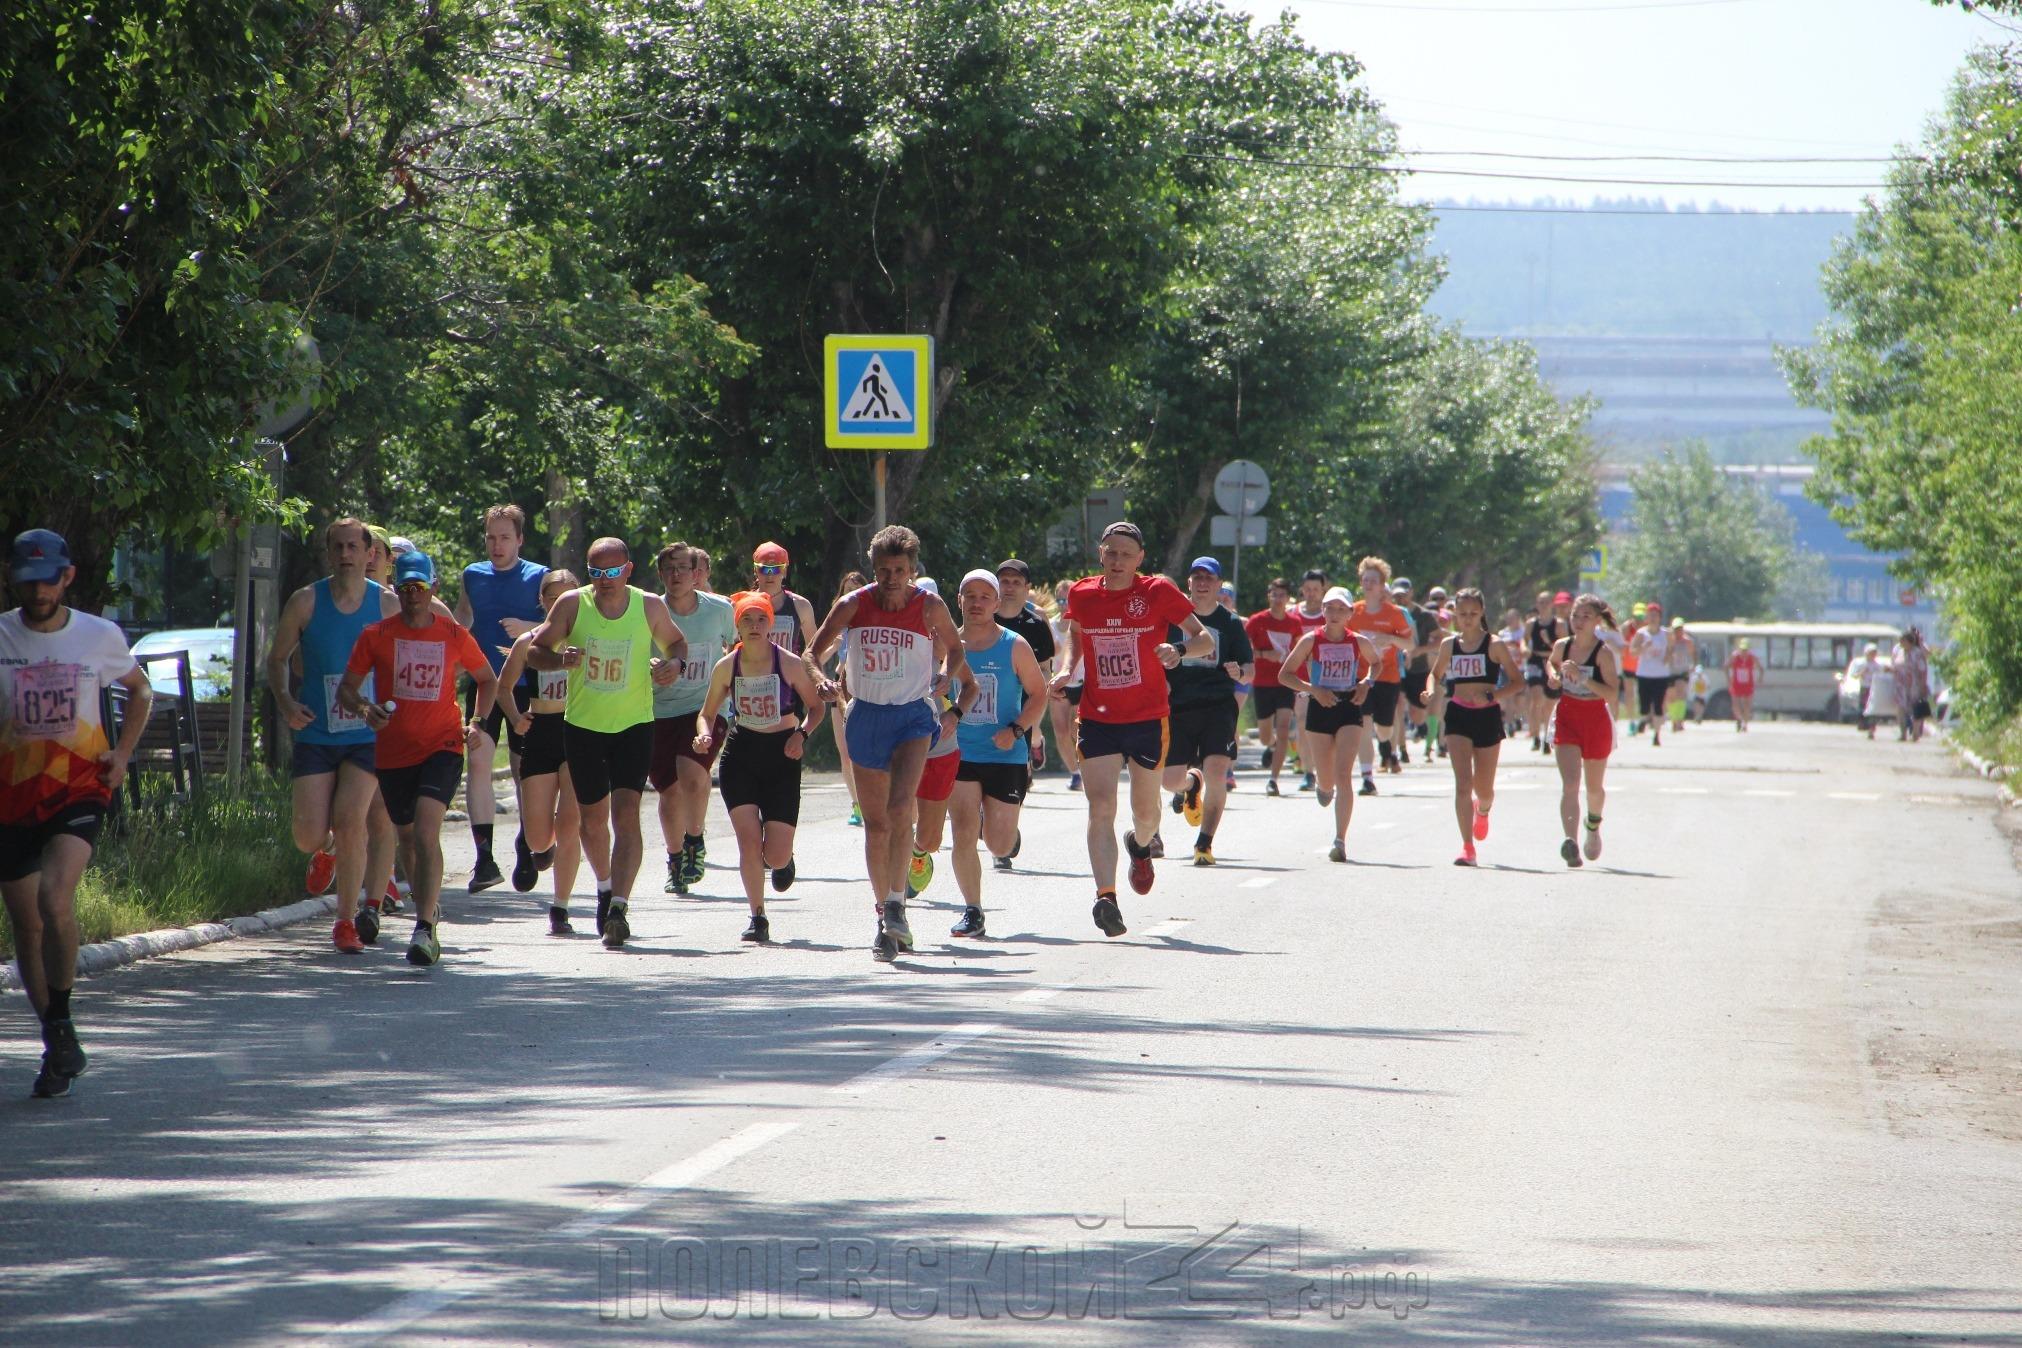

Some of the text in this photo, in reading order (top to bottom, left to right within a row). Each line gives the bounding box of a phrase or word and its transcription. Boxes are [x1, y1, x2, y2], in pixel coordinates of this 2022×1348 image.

[861, 628, 914, 650] RUSSIA
[399, 662, 440, 689] 432
[588, 655, 623, 682] 516
[1098, 653, 1134, 677] 803
[1322, 660, 1351, 678] 828
[1454, 658, 1481, 676] 478
[24, 687, 76, 725] 825
[739, 694, 777, 718] 536
